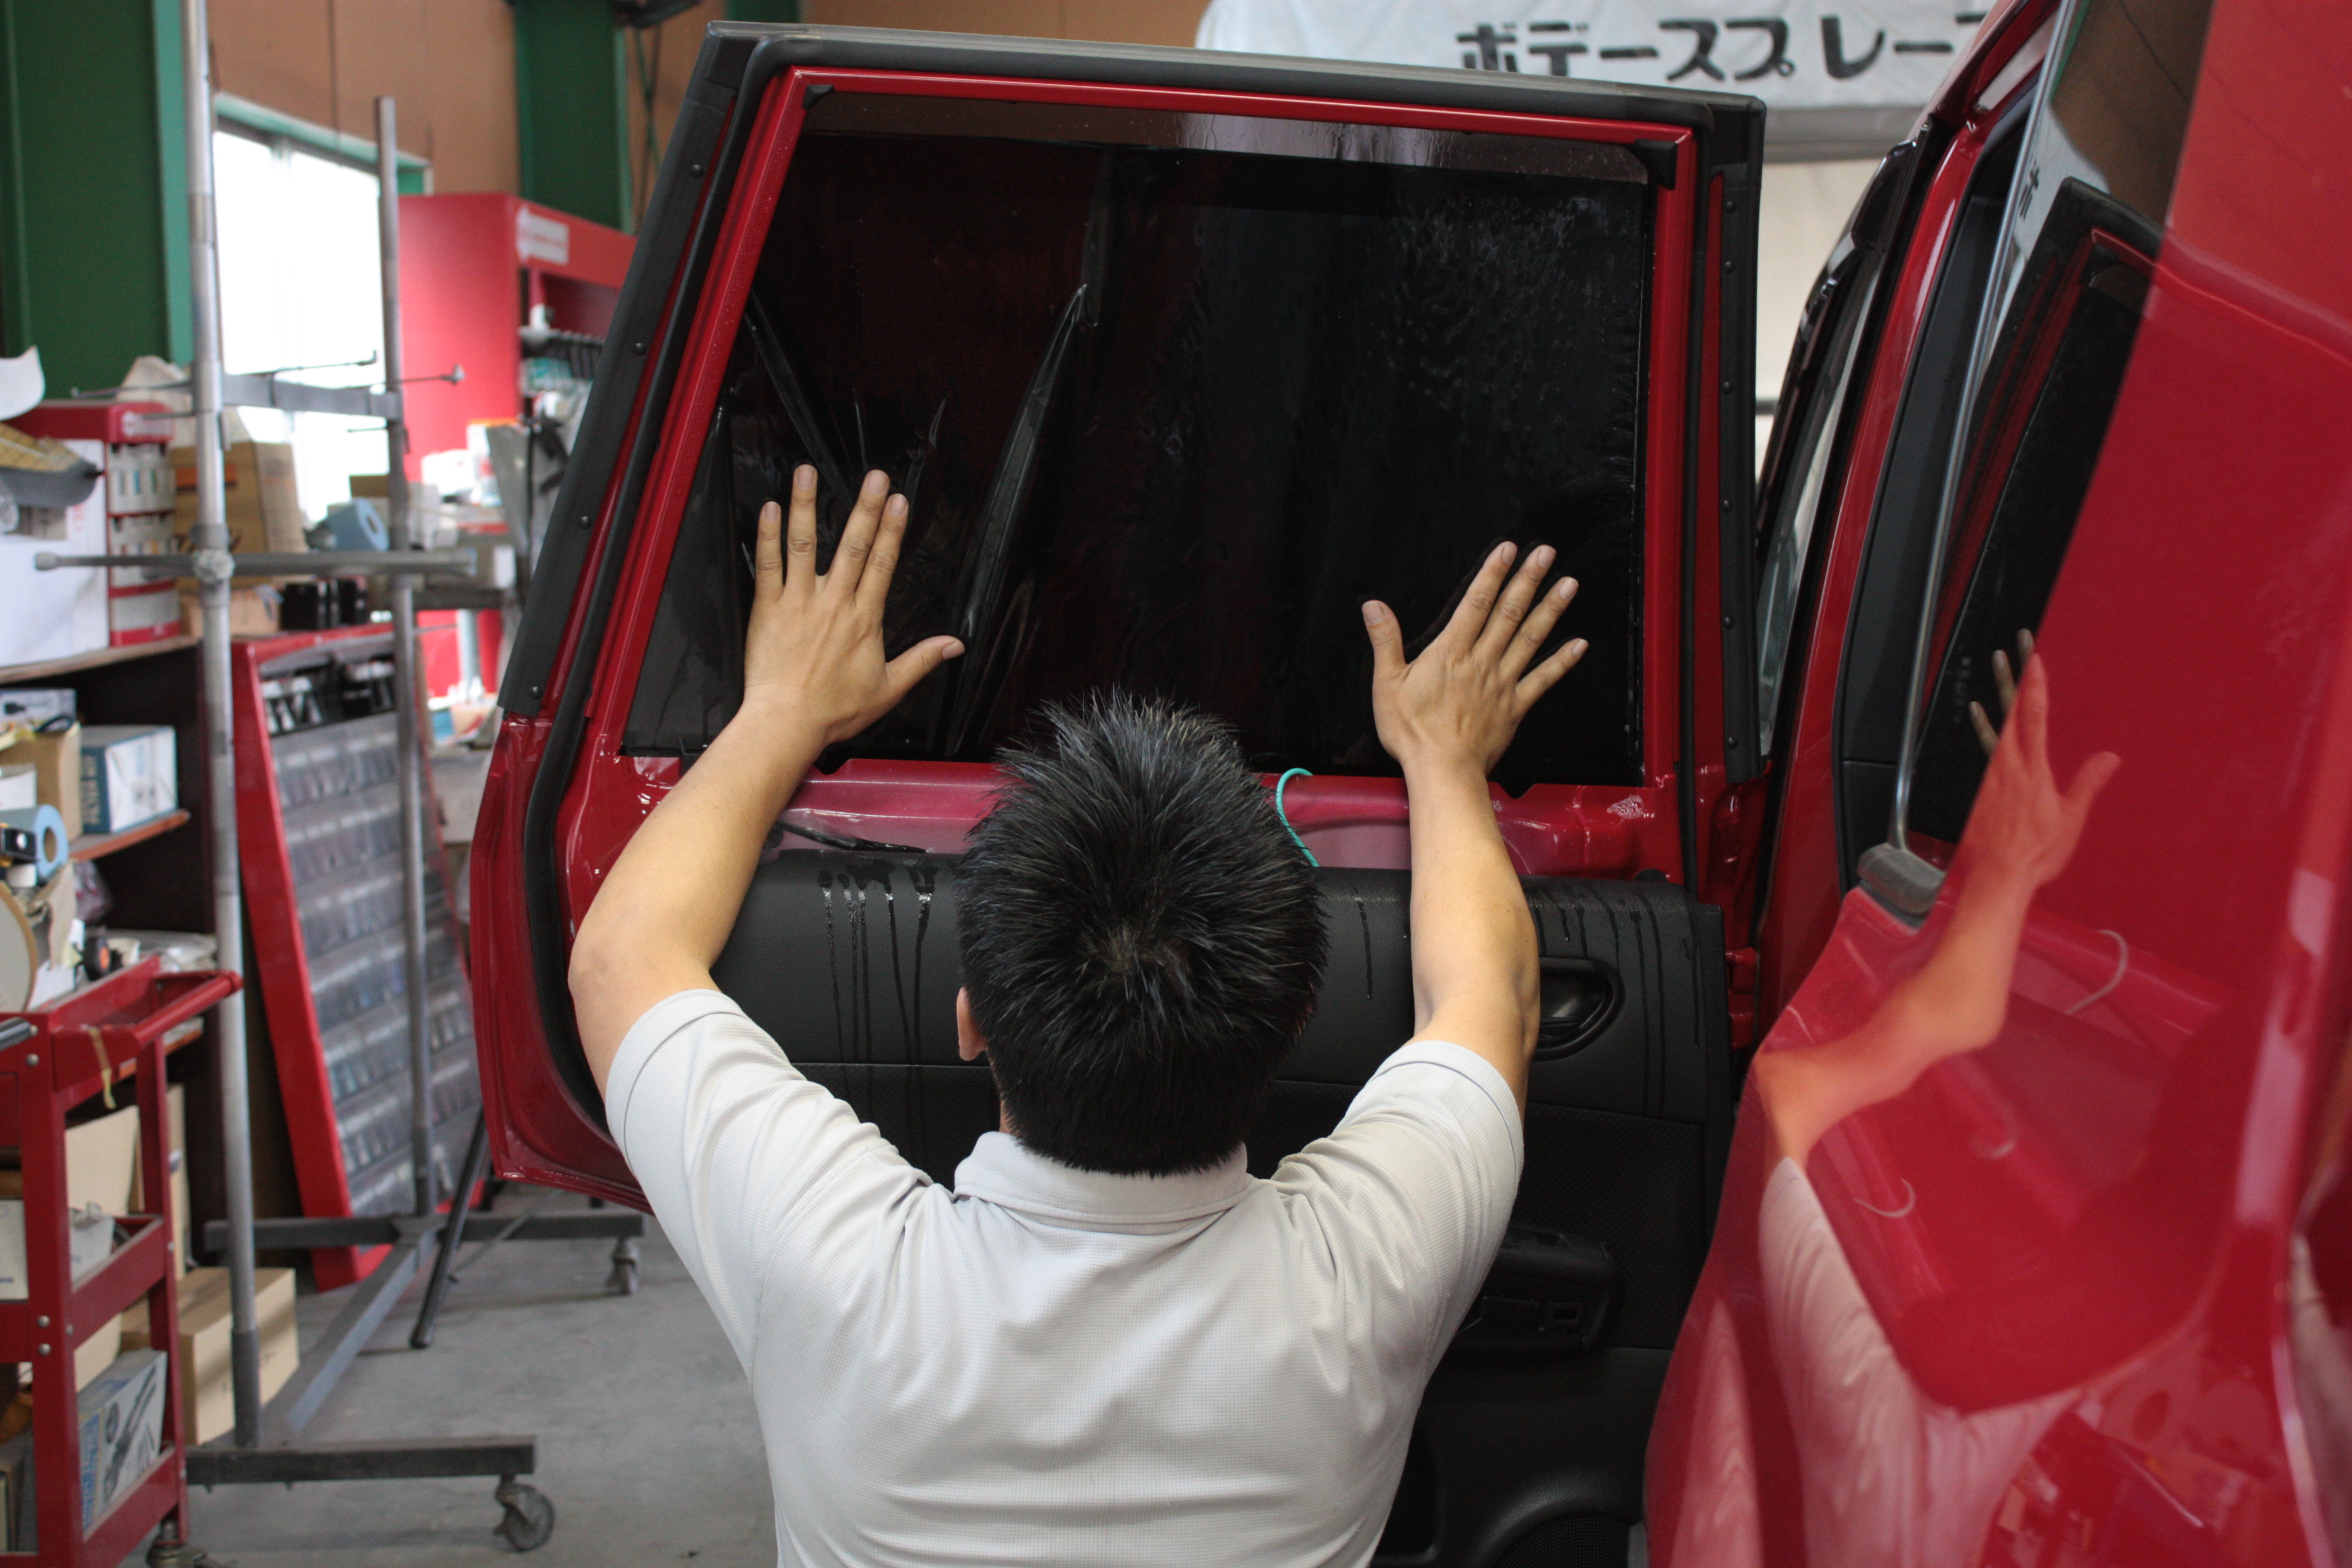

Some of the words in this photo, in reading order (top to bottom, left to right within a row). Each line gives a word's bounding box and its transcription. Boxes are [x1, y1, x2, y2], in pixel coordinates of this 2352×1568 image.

[1457, 14, 1988, 81] ボデースプレー
